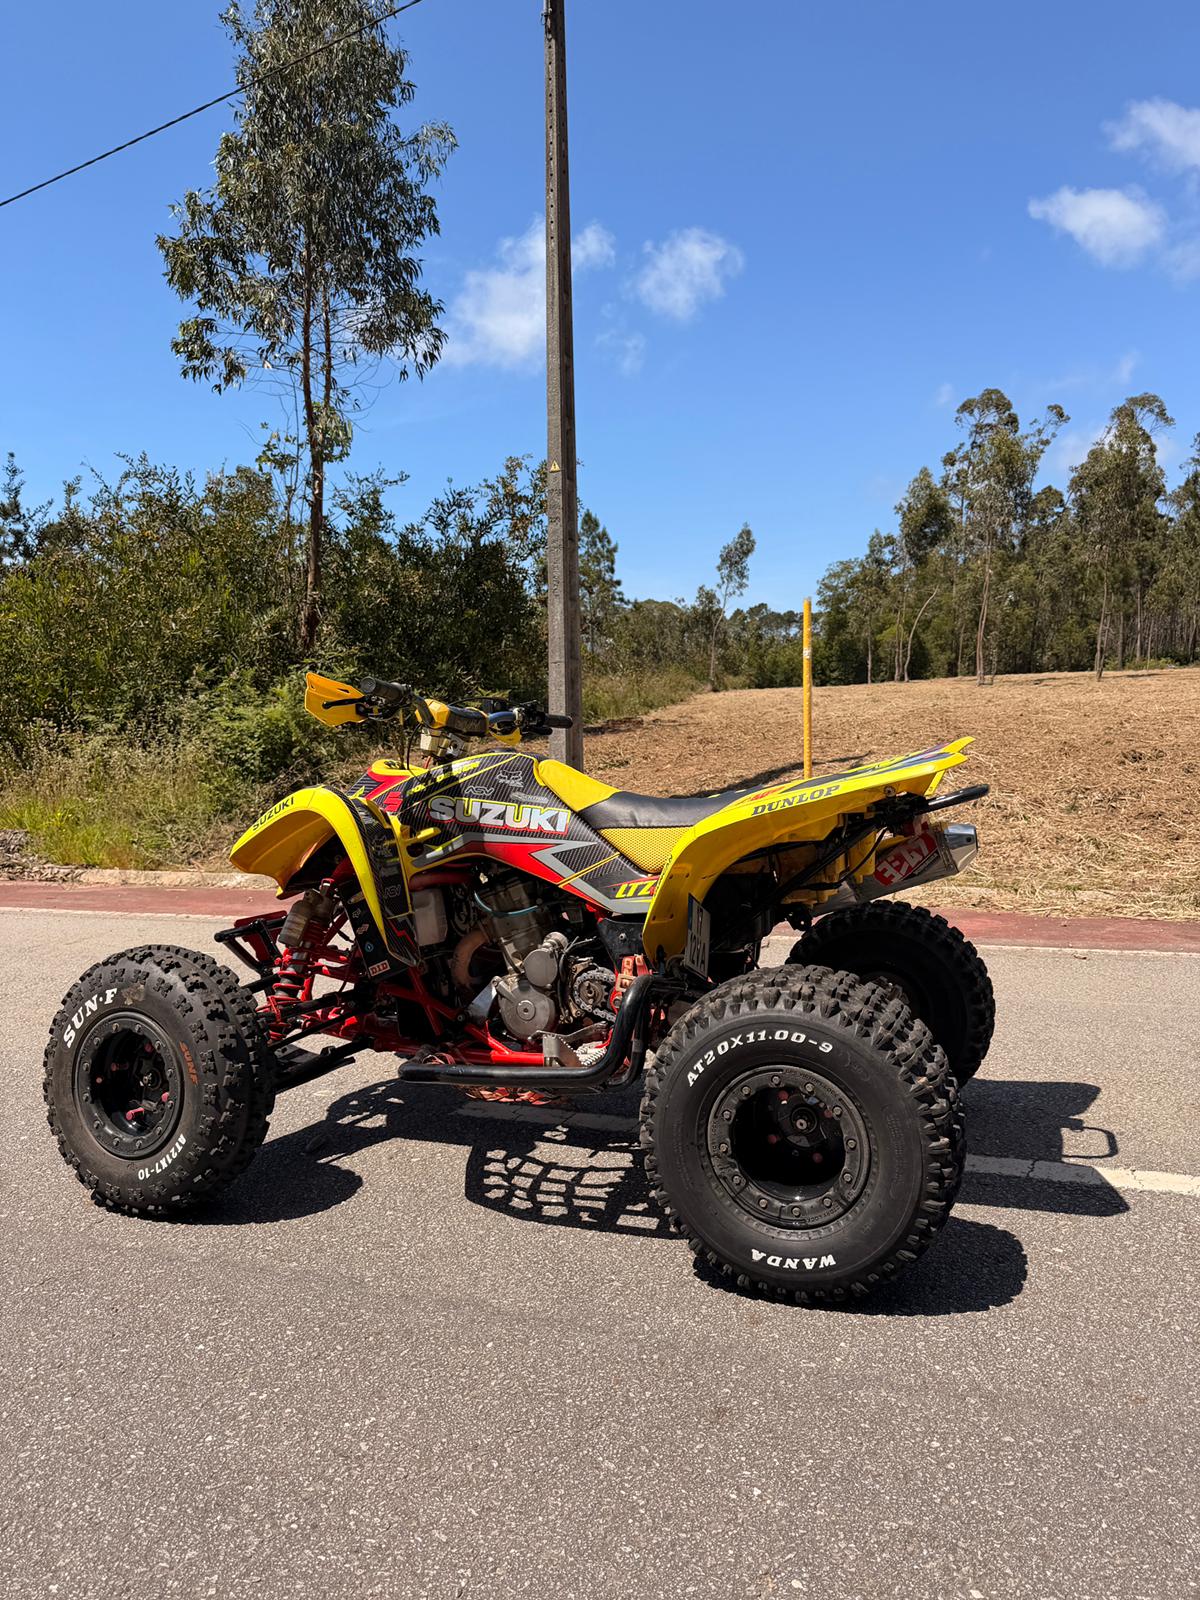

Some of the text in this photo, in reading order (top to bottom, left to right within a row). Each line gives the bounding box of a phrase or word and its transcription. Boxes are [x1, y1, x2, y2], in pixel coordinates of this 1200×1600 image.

[464, 785, 495, 796] ASV
[751, 785, 840, 816] DUNLOP
[253, 797, 294, 831] SUZUKI
[428, 796, 571, 835] SUZUKI
[751, 1248, 837, 1270] WANDA
